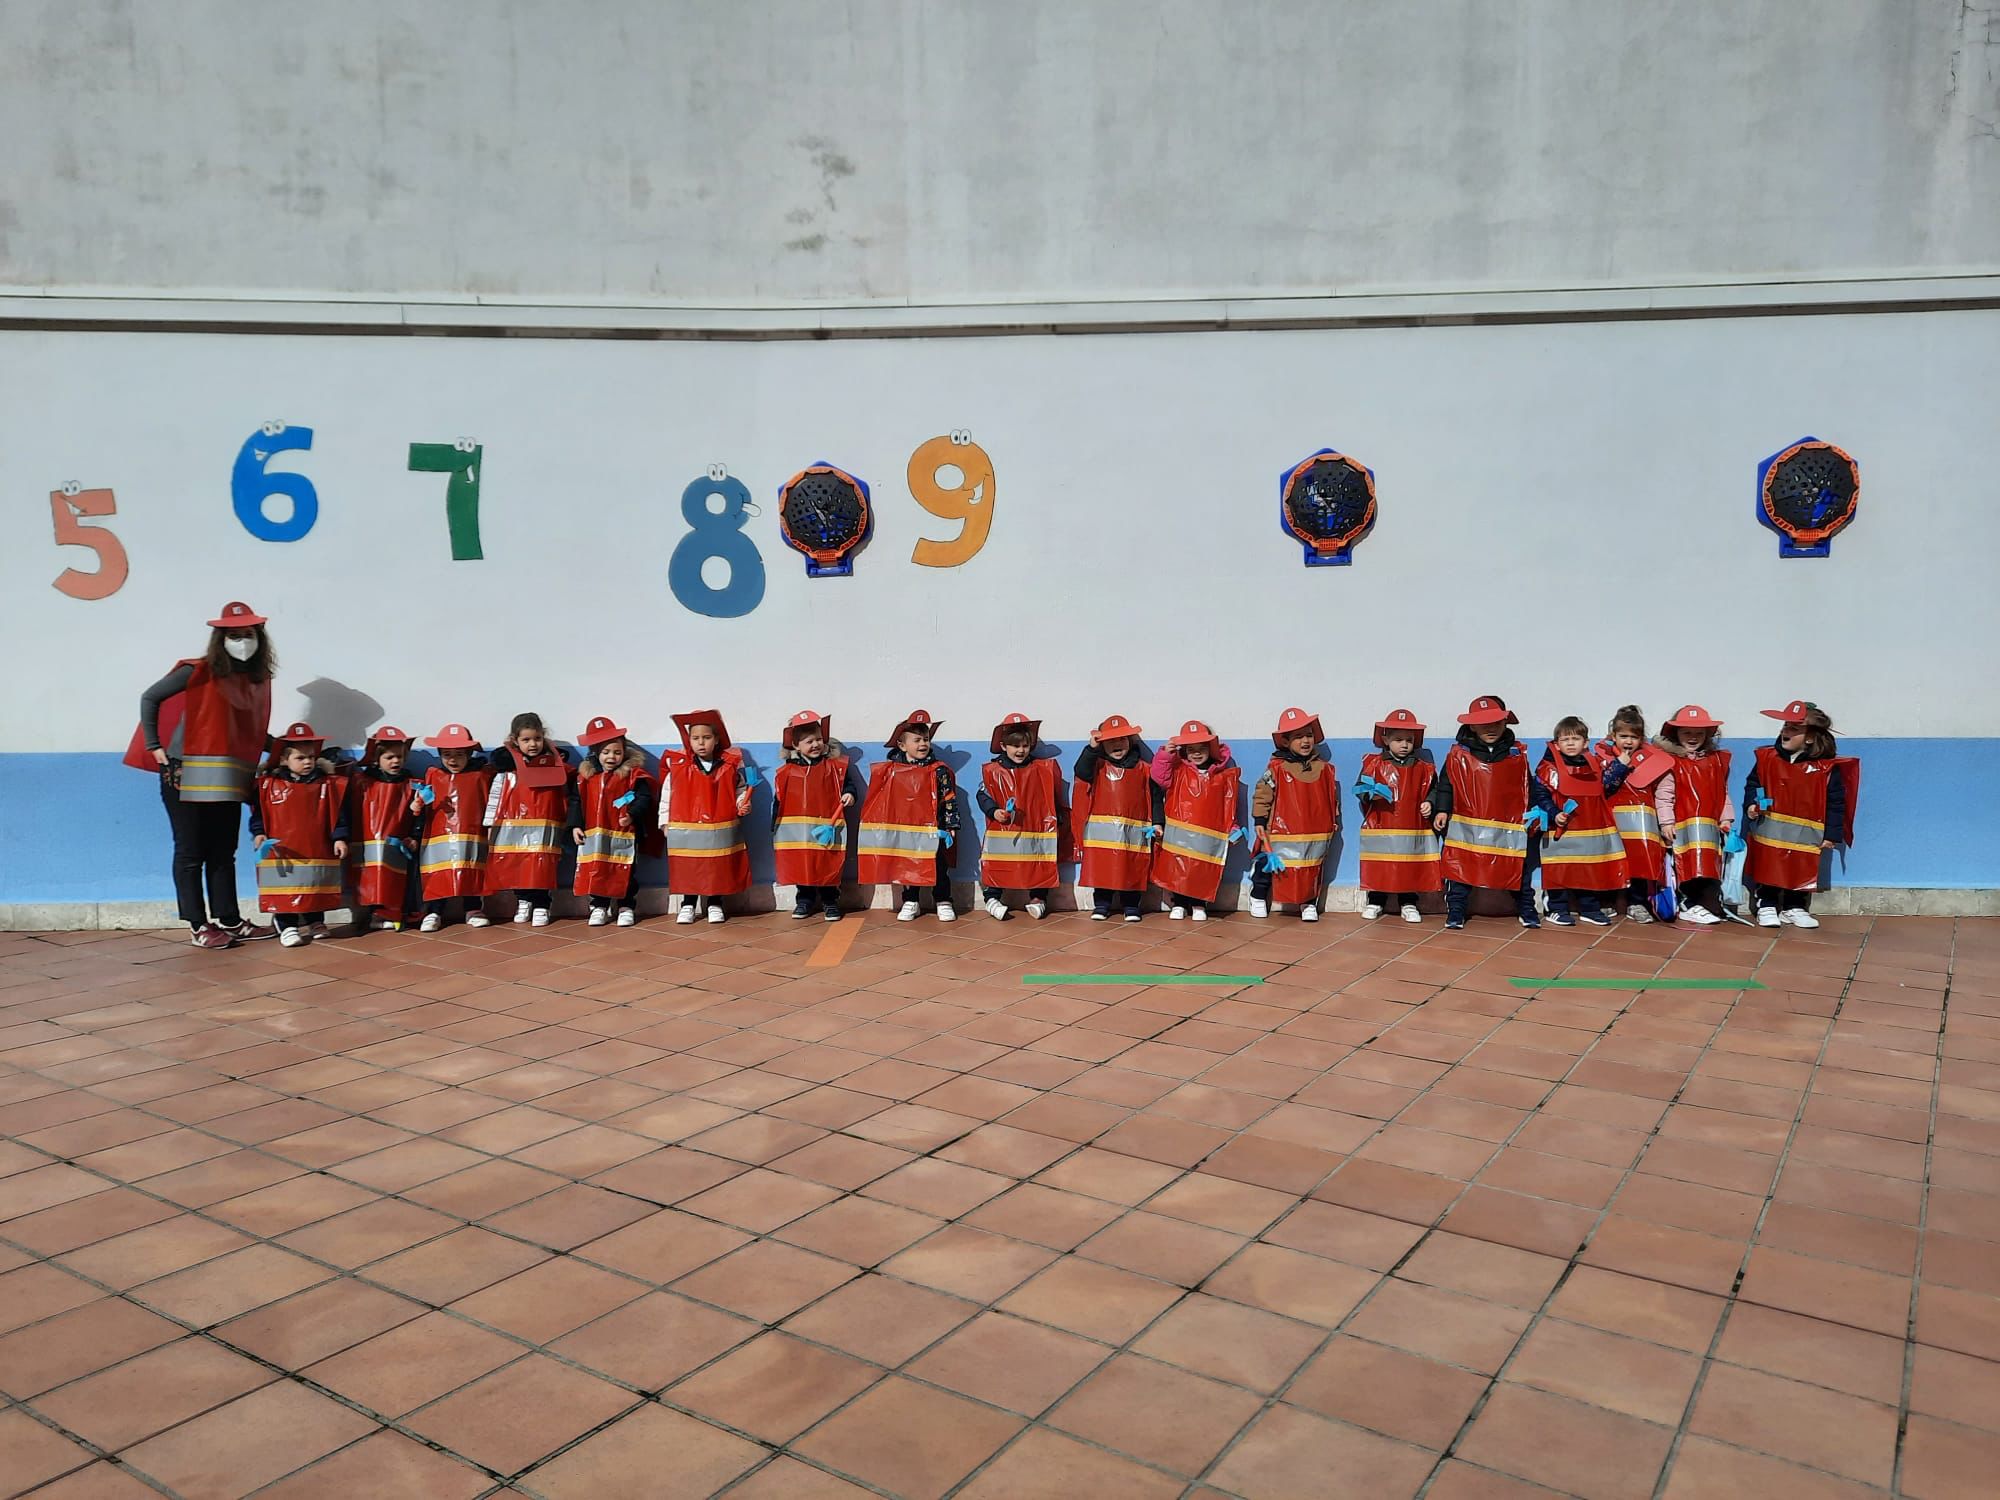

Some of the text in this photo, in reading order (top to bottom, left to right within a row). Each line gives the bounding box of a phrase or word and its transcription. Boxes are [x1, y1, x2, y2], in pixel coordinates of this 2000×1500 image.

[231, 425, 319, 543] 6
[408, 443, 484, 560] 7
[907, 435, 997, 568] 9
[50, 488, 129, 600] 5
[669, 474, 766, 619] 8
